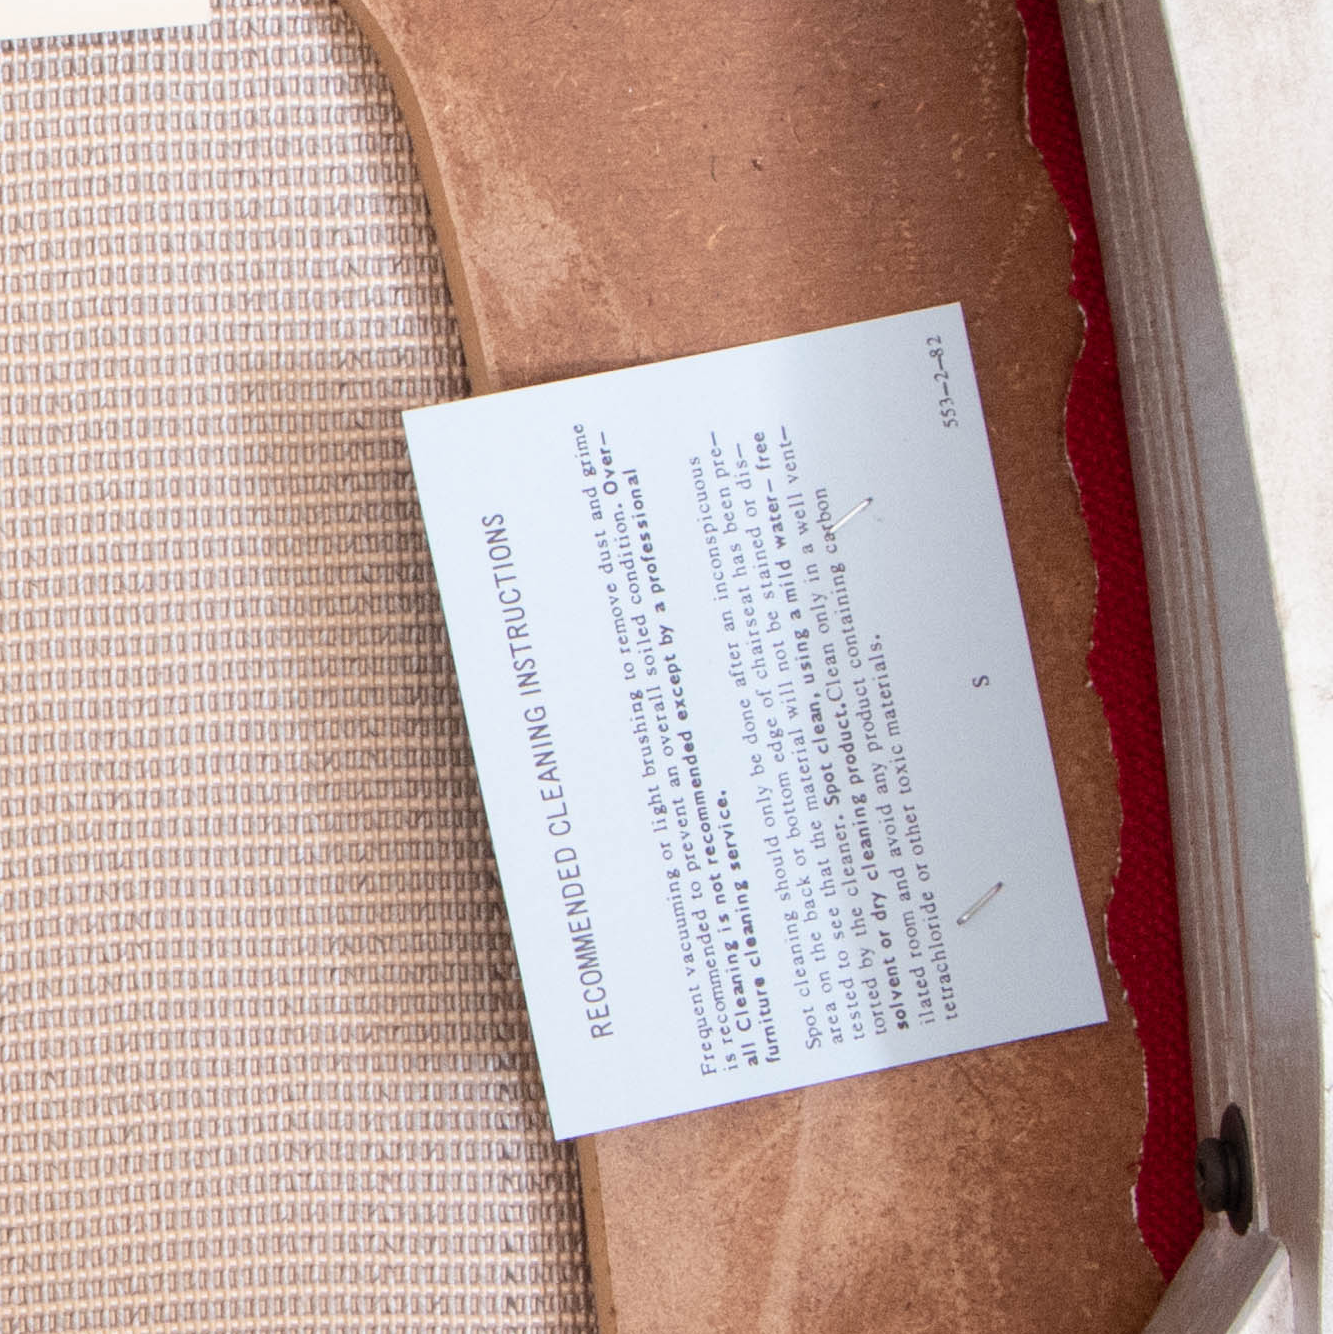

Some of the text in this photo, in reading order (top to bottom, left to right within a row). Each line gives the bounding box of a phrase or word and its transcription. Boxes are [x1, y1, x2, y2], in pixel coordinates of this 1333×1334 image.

[925, 334, 959, 427] 553-2-82
[481, 513, 613, 1038] RECOMMENDED CLEANING INSTRUCTIONS
[621, 468, 759, 1066] all Cleaning is not recommended except by a professional
[971, 674, 989, 687] S
[716, 789, 781, 1063] furniture cleaning service.
